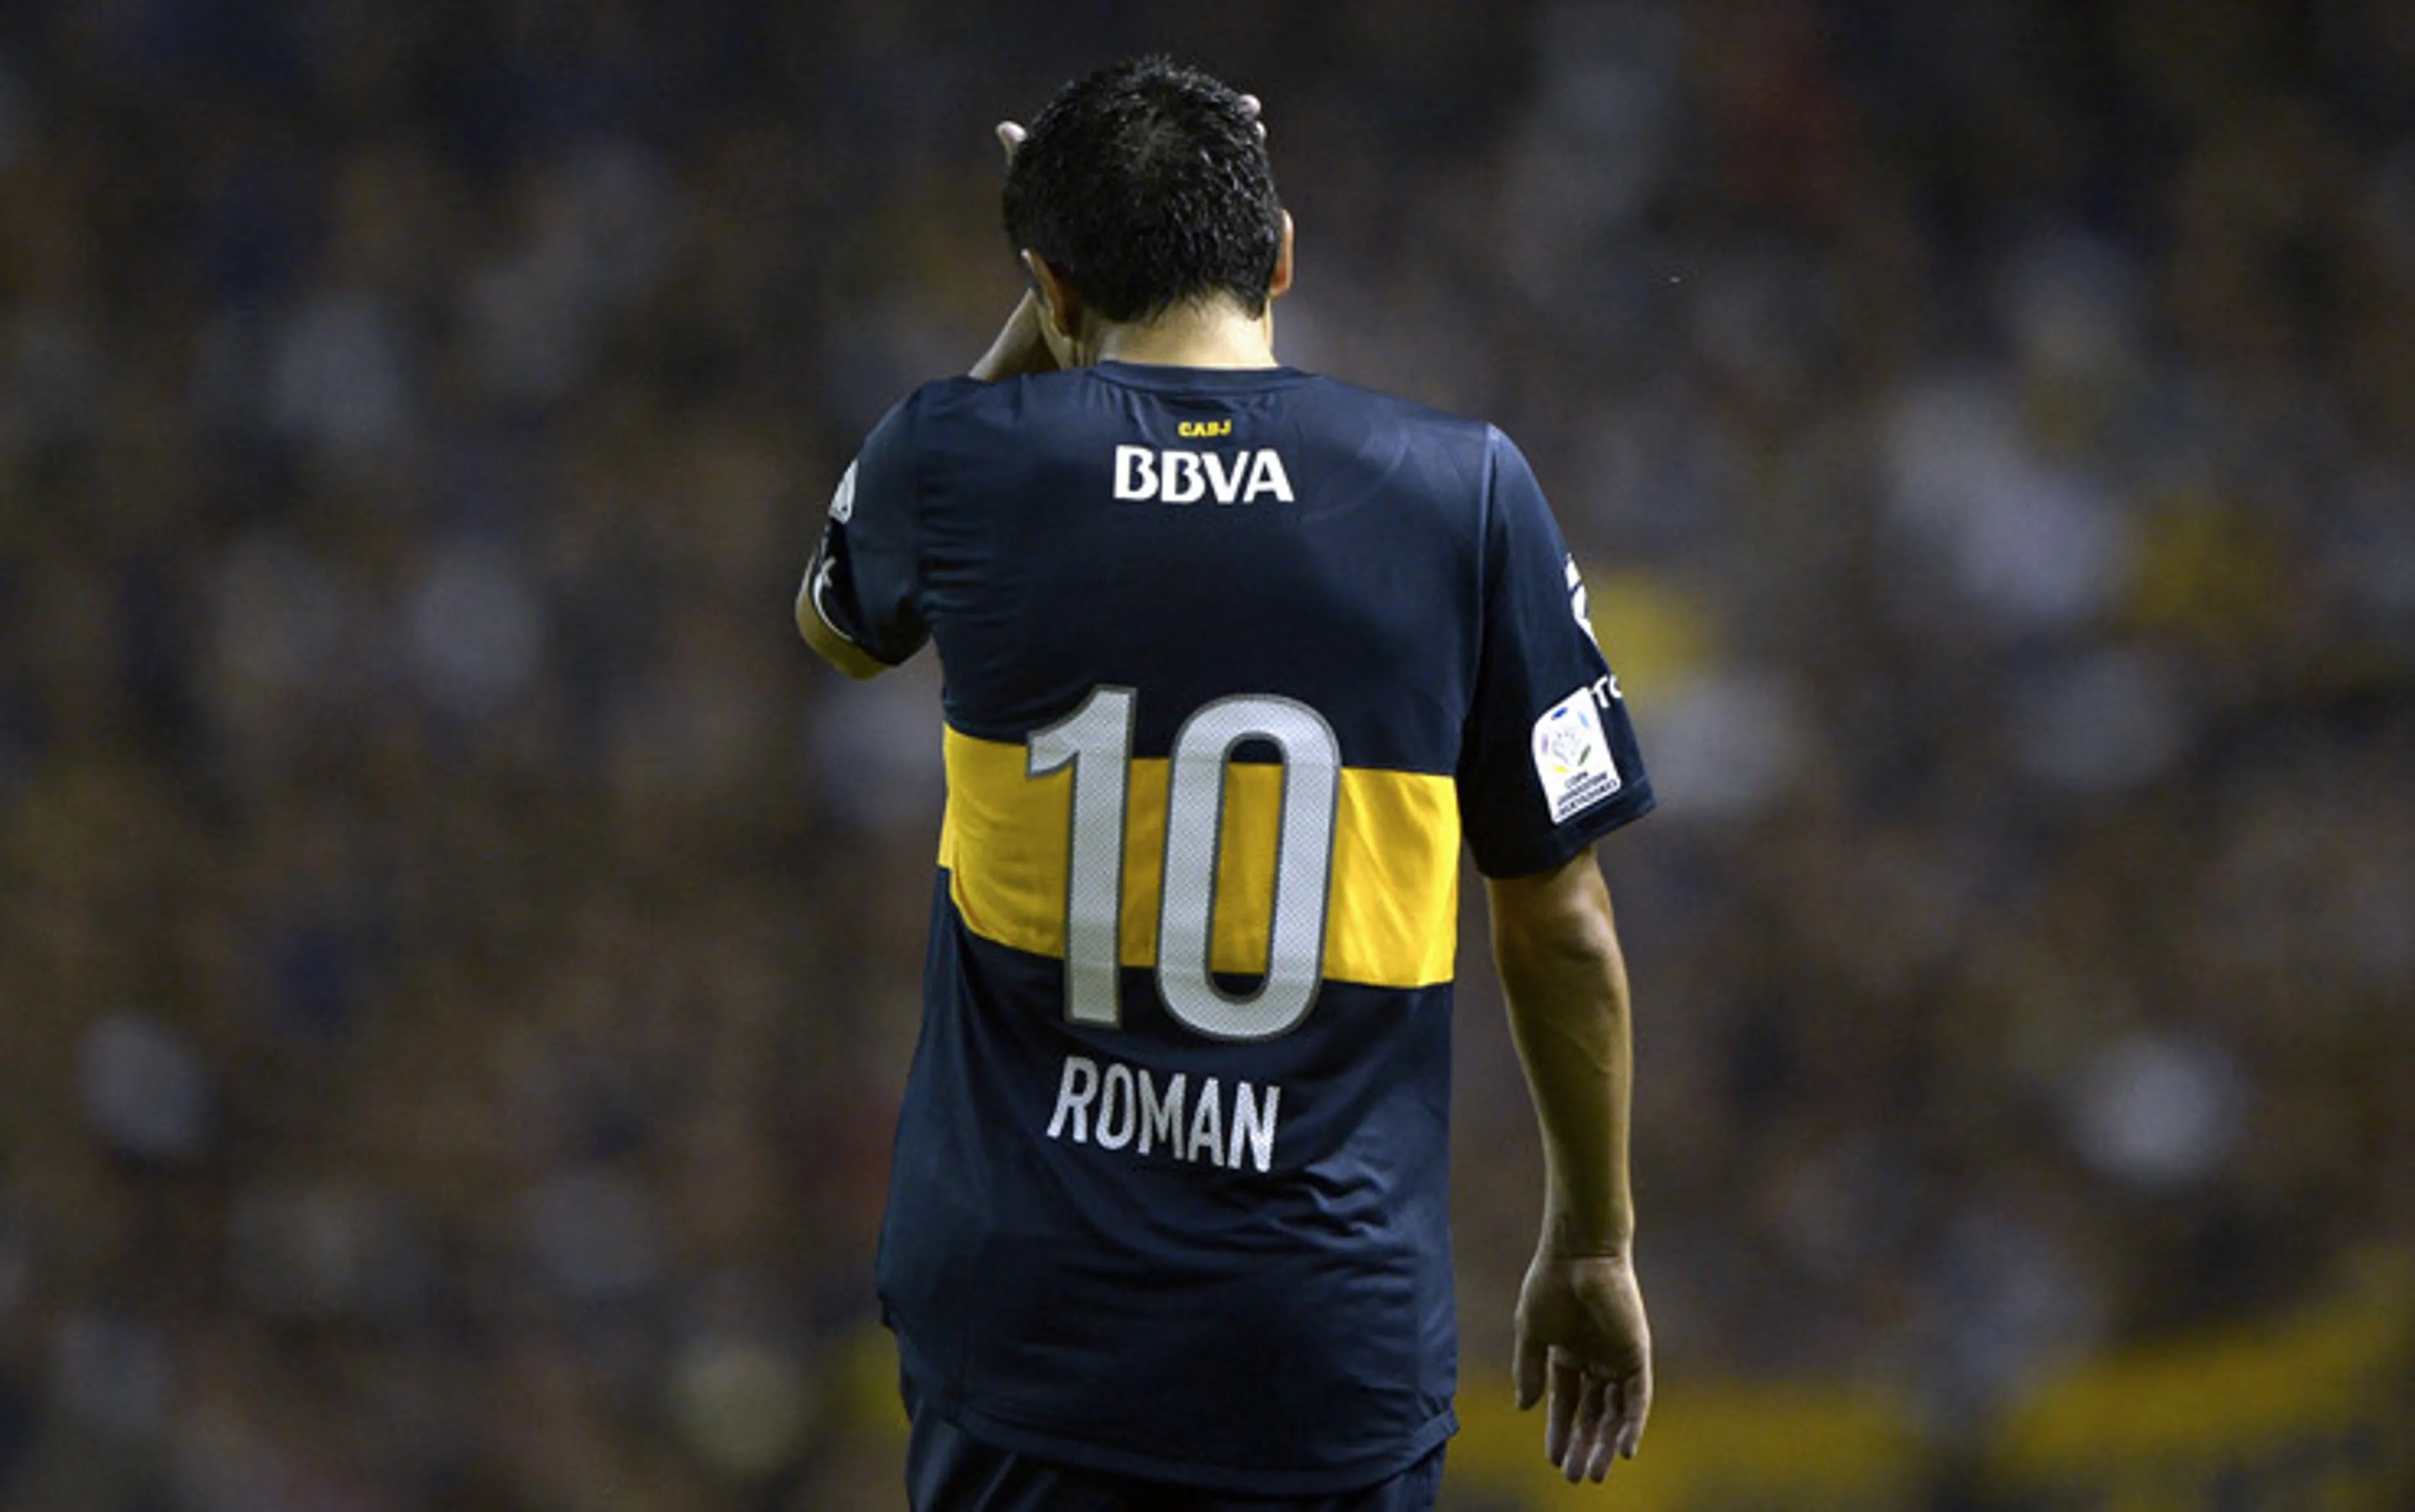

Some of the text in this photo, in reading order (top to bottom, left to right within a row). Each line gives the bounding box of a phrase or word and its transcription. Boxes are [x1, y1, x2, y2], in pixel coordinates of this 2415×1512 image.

[1177, 419, 1232, 437] CABJ
[1114, 445, 1295, 503] BBVA
[1026, 684, 1341, 1042] 10
[1046, 1056, 1280, 1173] ROMAN
